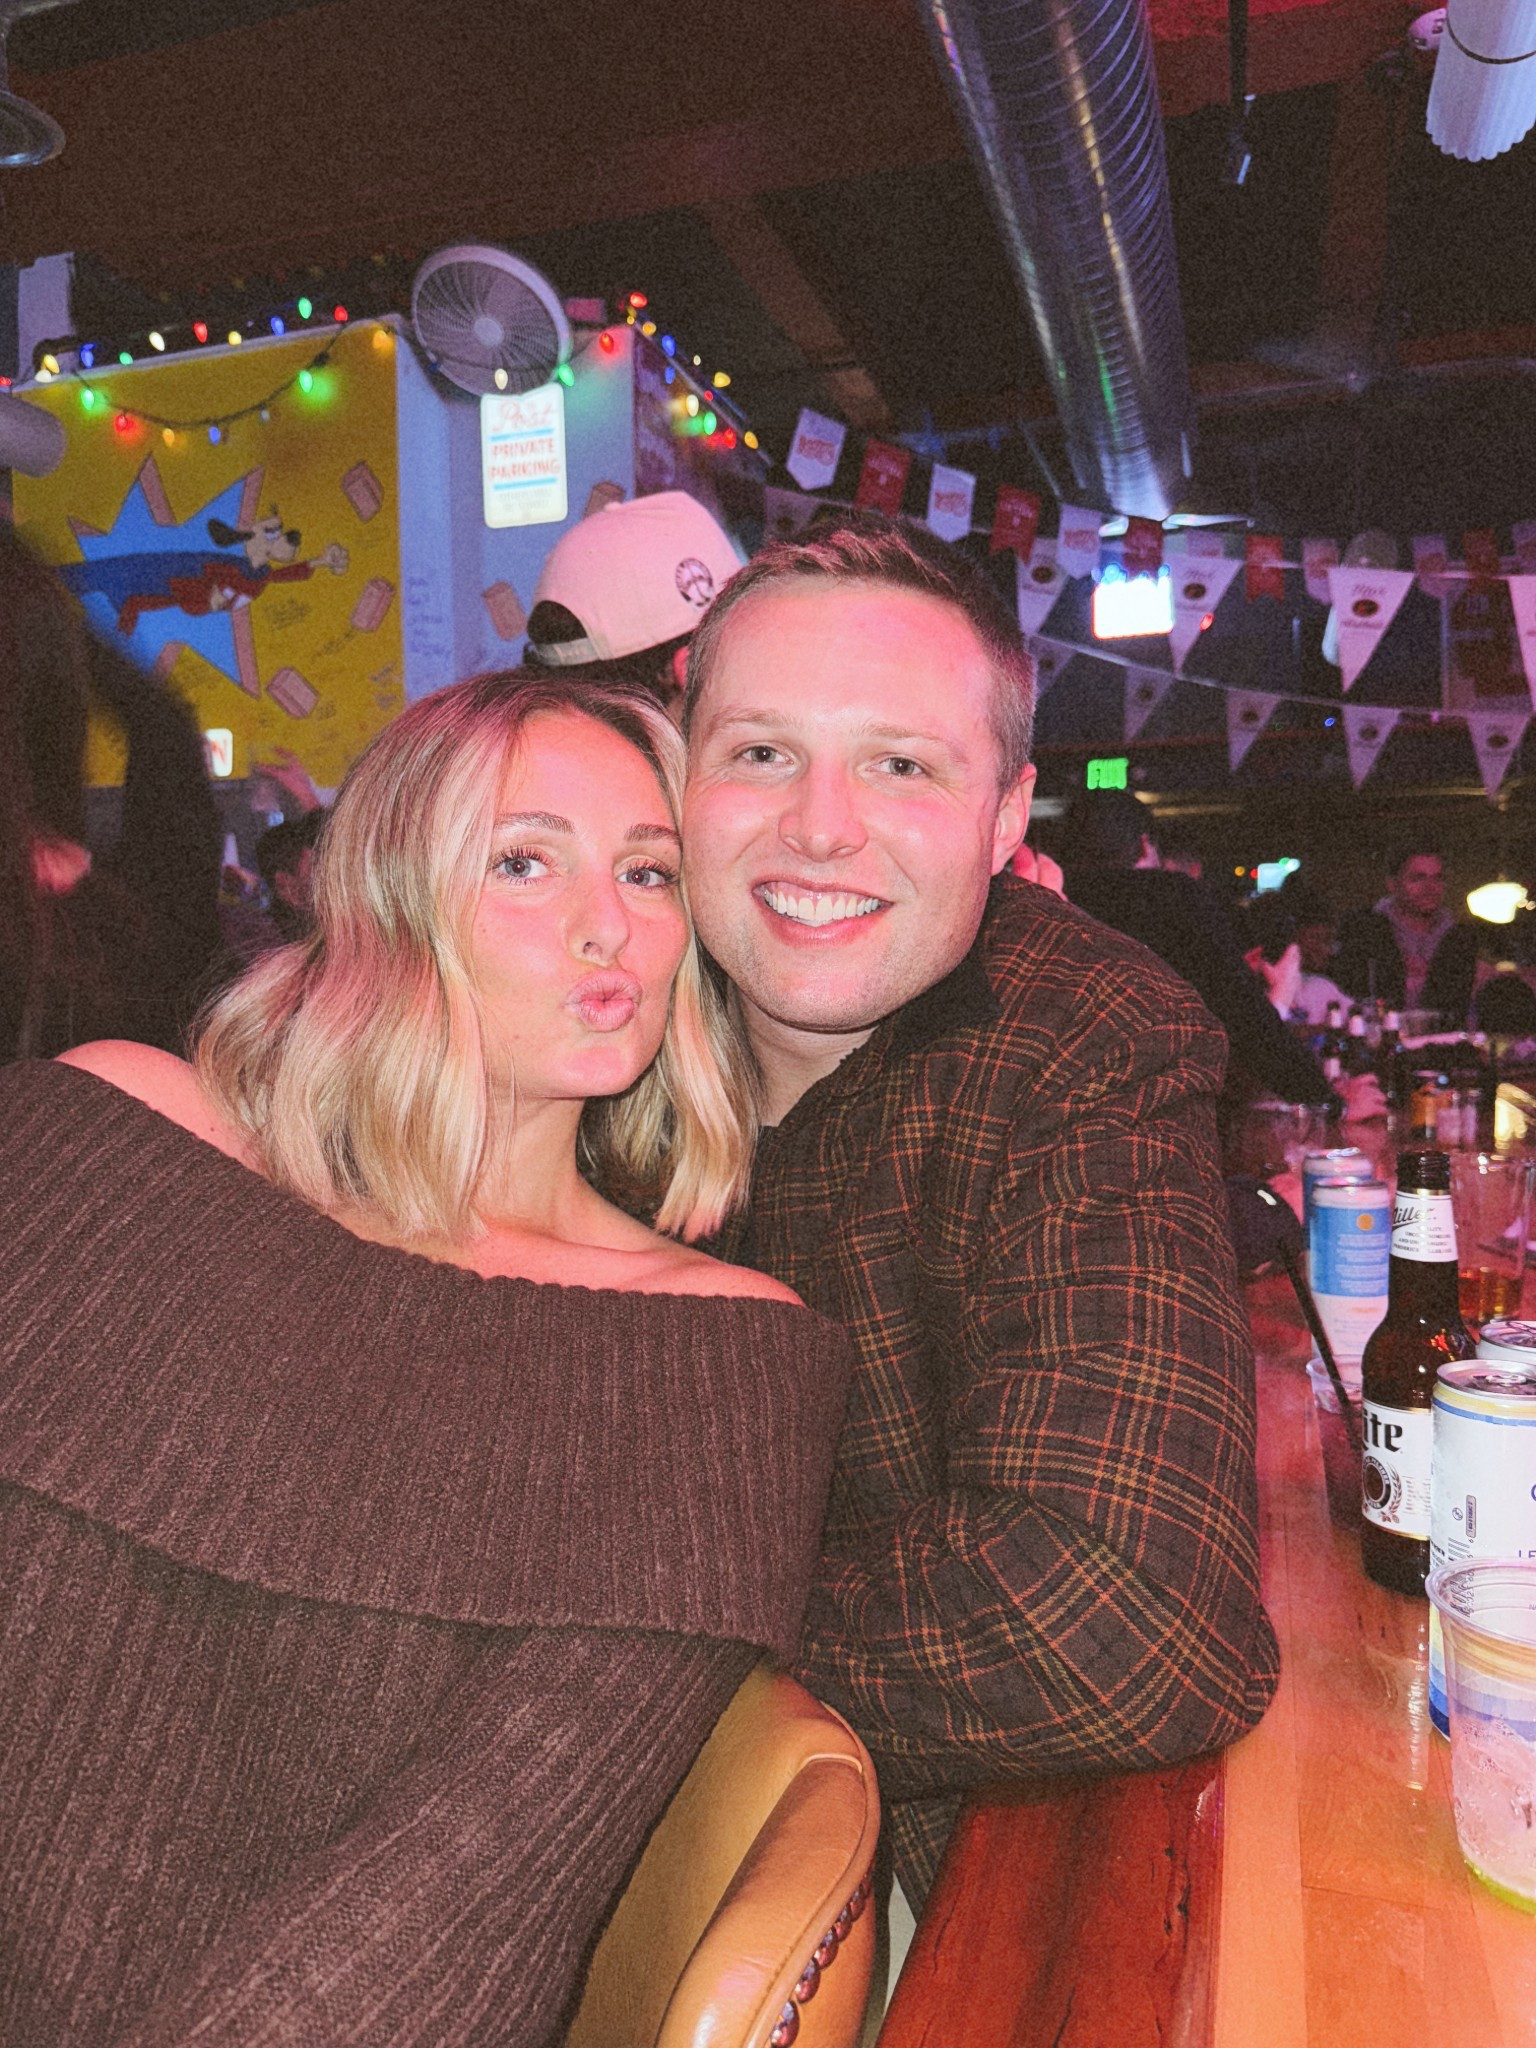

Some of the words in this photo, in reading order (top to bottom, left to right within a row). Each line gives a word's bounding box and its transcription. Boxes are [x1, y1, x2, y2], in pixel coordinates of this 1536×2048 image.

[491, 438, 555, 456] PRIVATE
[490, 459, 560, 478] PARKING
[1363, 1407, 1403, 1453] ite
